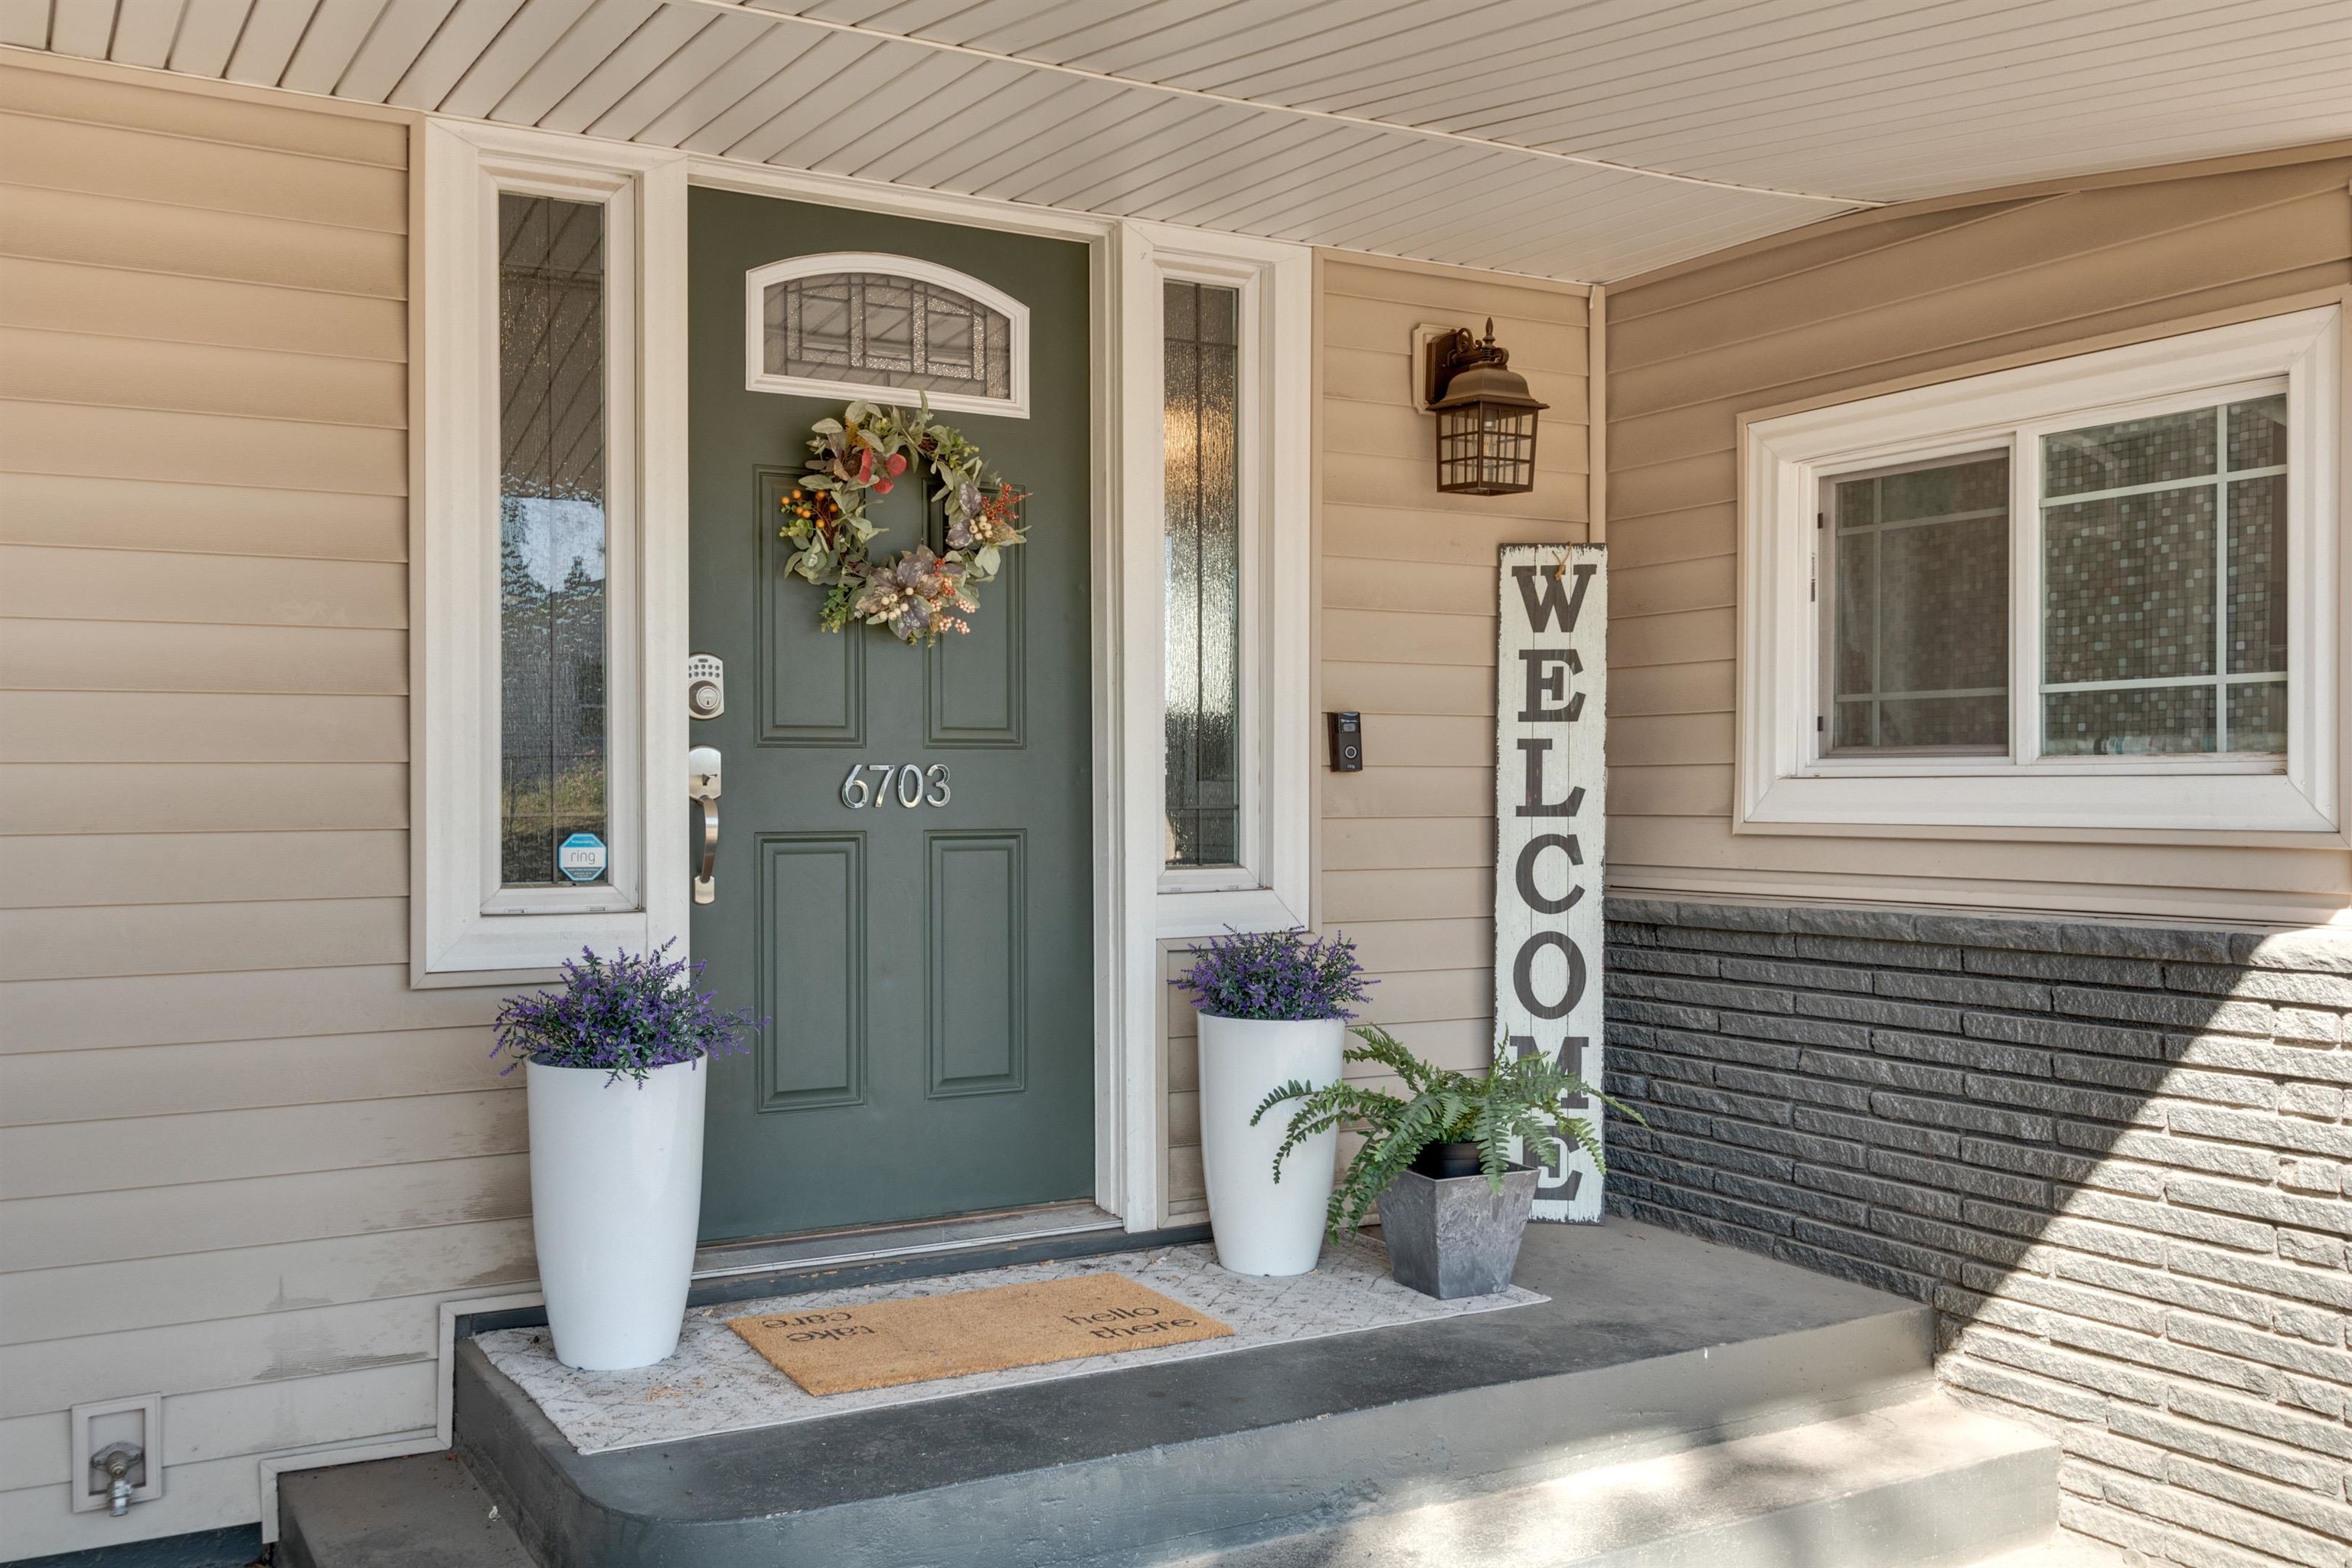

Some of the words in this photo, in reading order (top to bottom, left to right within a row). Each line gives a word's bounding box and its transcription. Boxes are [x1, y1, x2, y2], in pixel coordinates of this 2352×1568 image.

[841, 763, 951, 808] 6703
[570, 850, 595, 864] ring
[762, 1312, 852, 1328] care
[1063, 1307, 1160, 1326] hello
[786, 1325, 876, 1342] take
[1089, 1318, 1198, 1339] there
